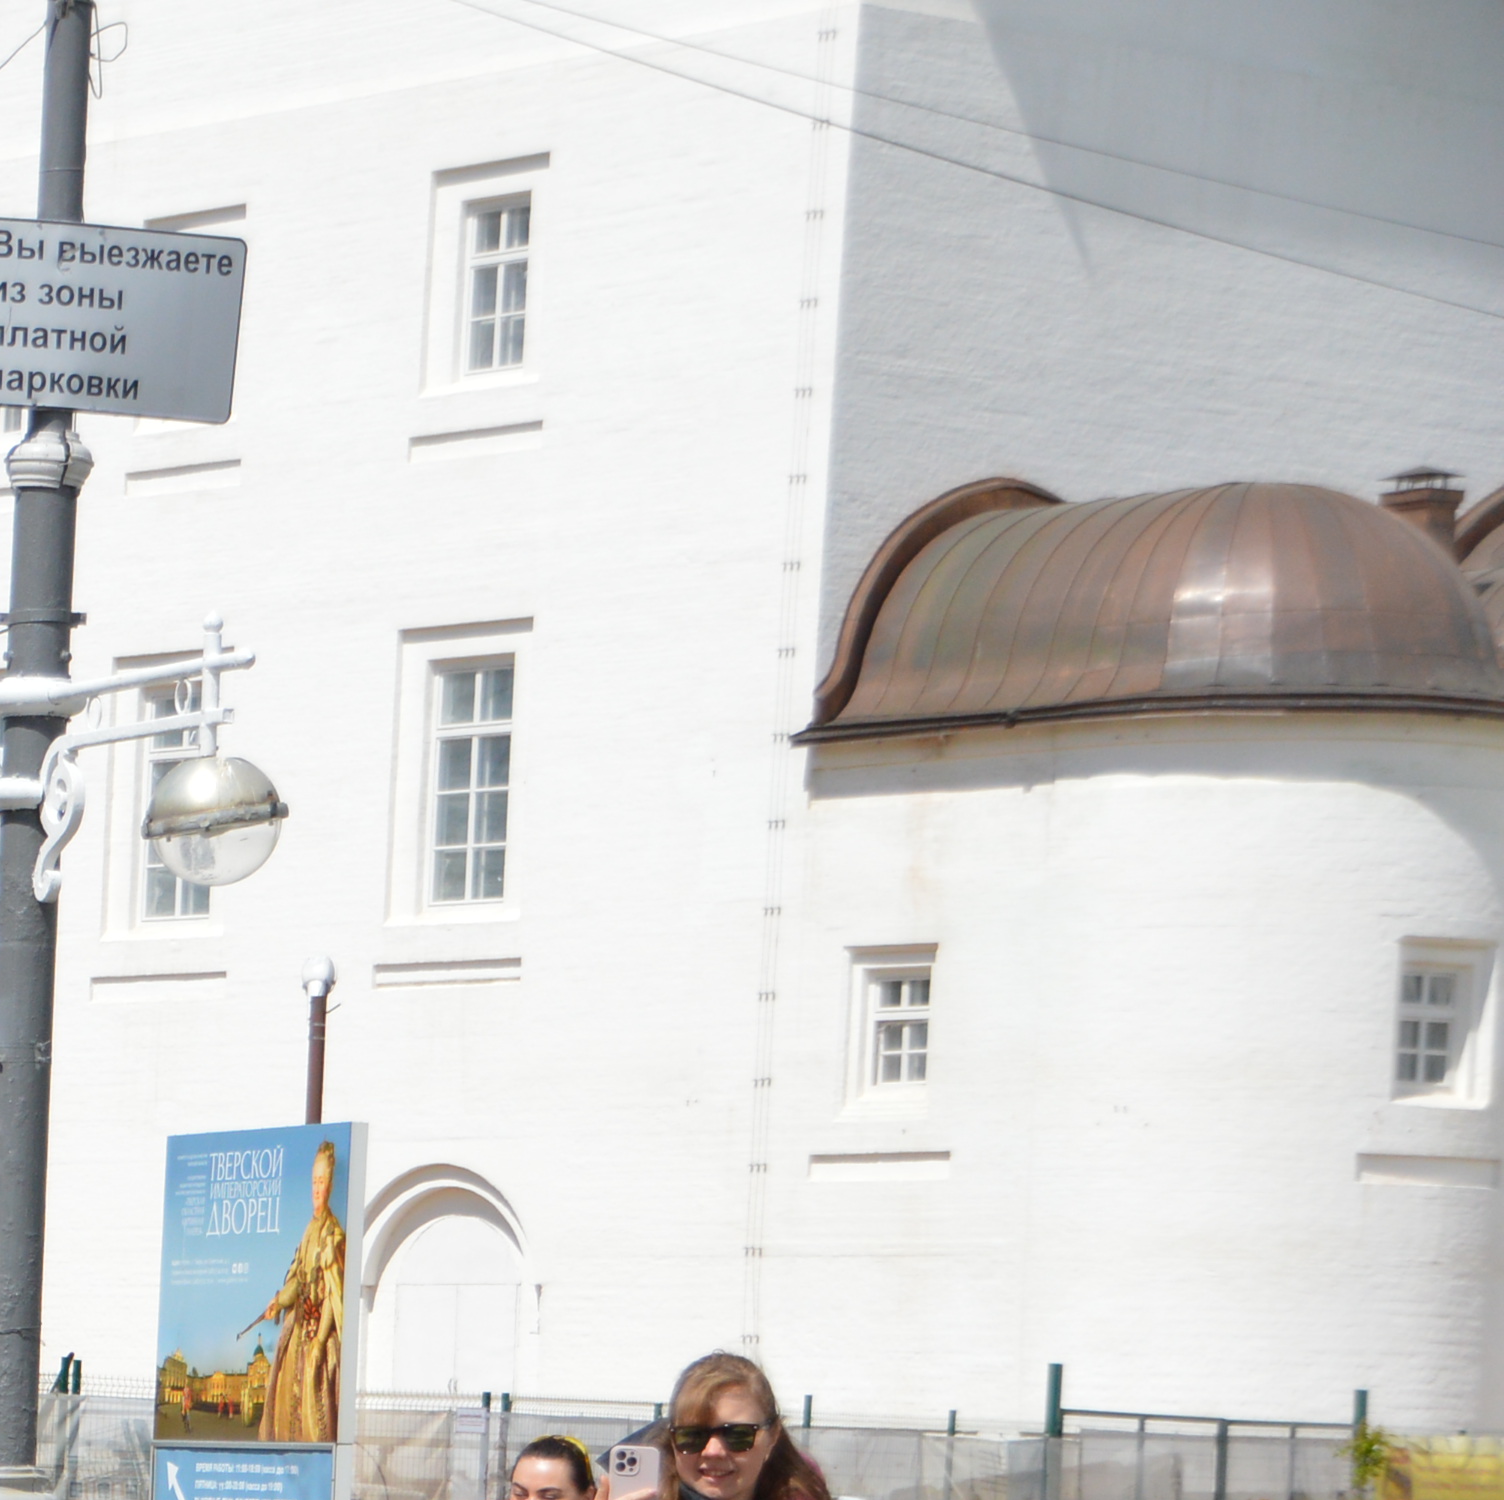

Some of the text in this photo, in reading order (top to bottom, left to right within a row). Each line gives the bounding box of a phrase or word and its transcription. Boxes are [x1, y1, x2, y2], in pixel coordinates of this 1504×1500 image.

[57, 240, 234, 277] выезжаете
[37, 284, 125, 311] зоны
[209, 1144, 284, 1182] ТВЕРСКОЙ
[209, 1177, 282, 1199] ИМПЕРАТОРСКИЙ
[206, 1197, 281, 1238] ДВОРЕЦ
